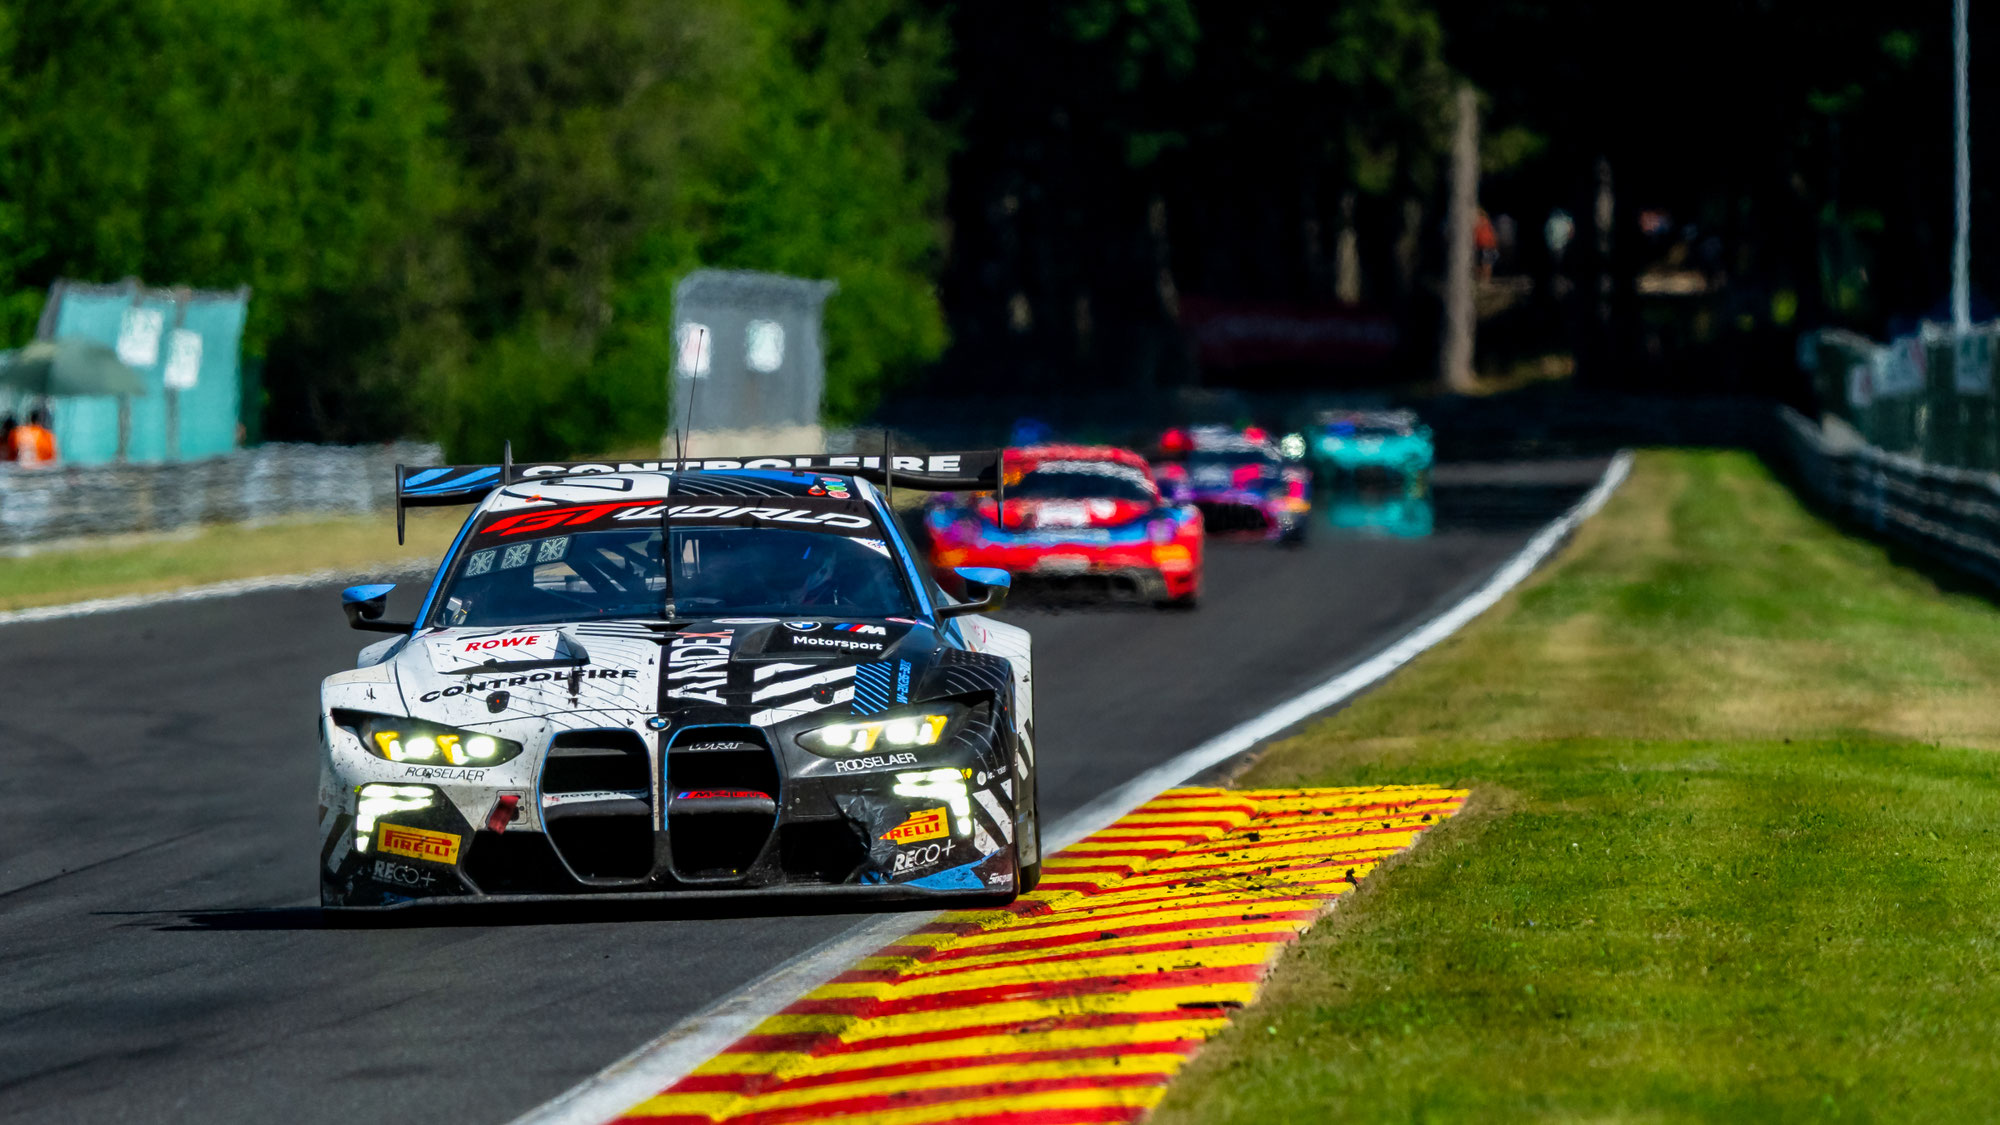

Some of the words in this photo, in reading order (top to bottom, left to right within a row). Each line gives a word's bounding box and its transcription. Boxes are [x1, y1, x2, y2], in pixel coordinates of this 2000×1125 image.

[481, 499, 664, 537] GT
[612, 505, 872, 529] WORLD
[464, 635, 541, 652] ROWE
[793, 635, 883, 651] Motorsport
[419, 668, 639, 703] CONTROLFIRE
[834, 752, 918, 773] ROOSELAER
[404, 766, 485, 782] ROOSELAER
[384, 829, 453, 857] PIRELLI
